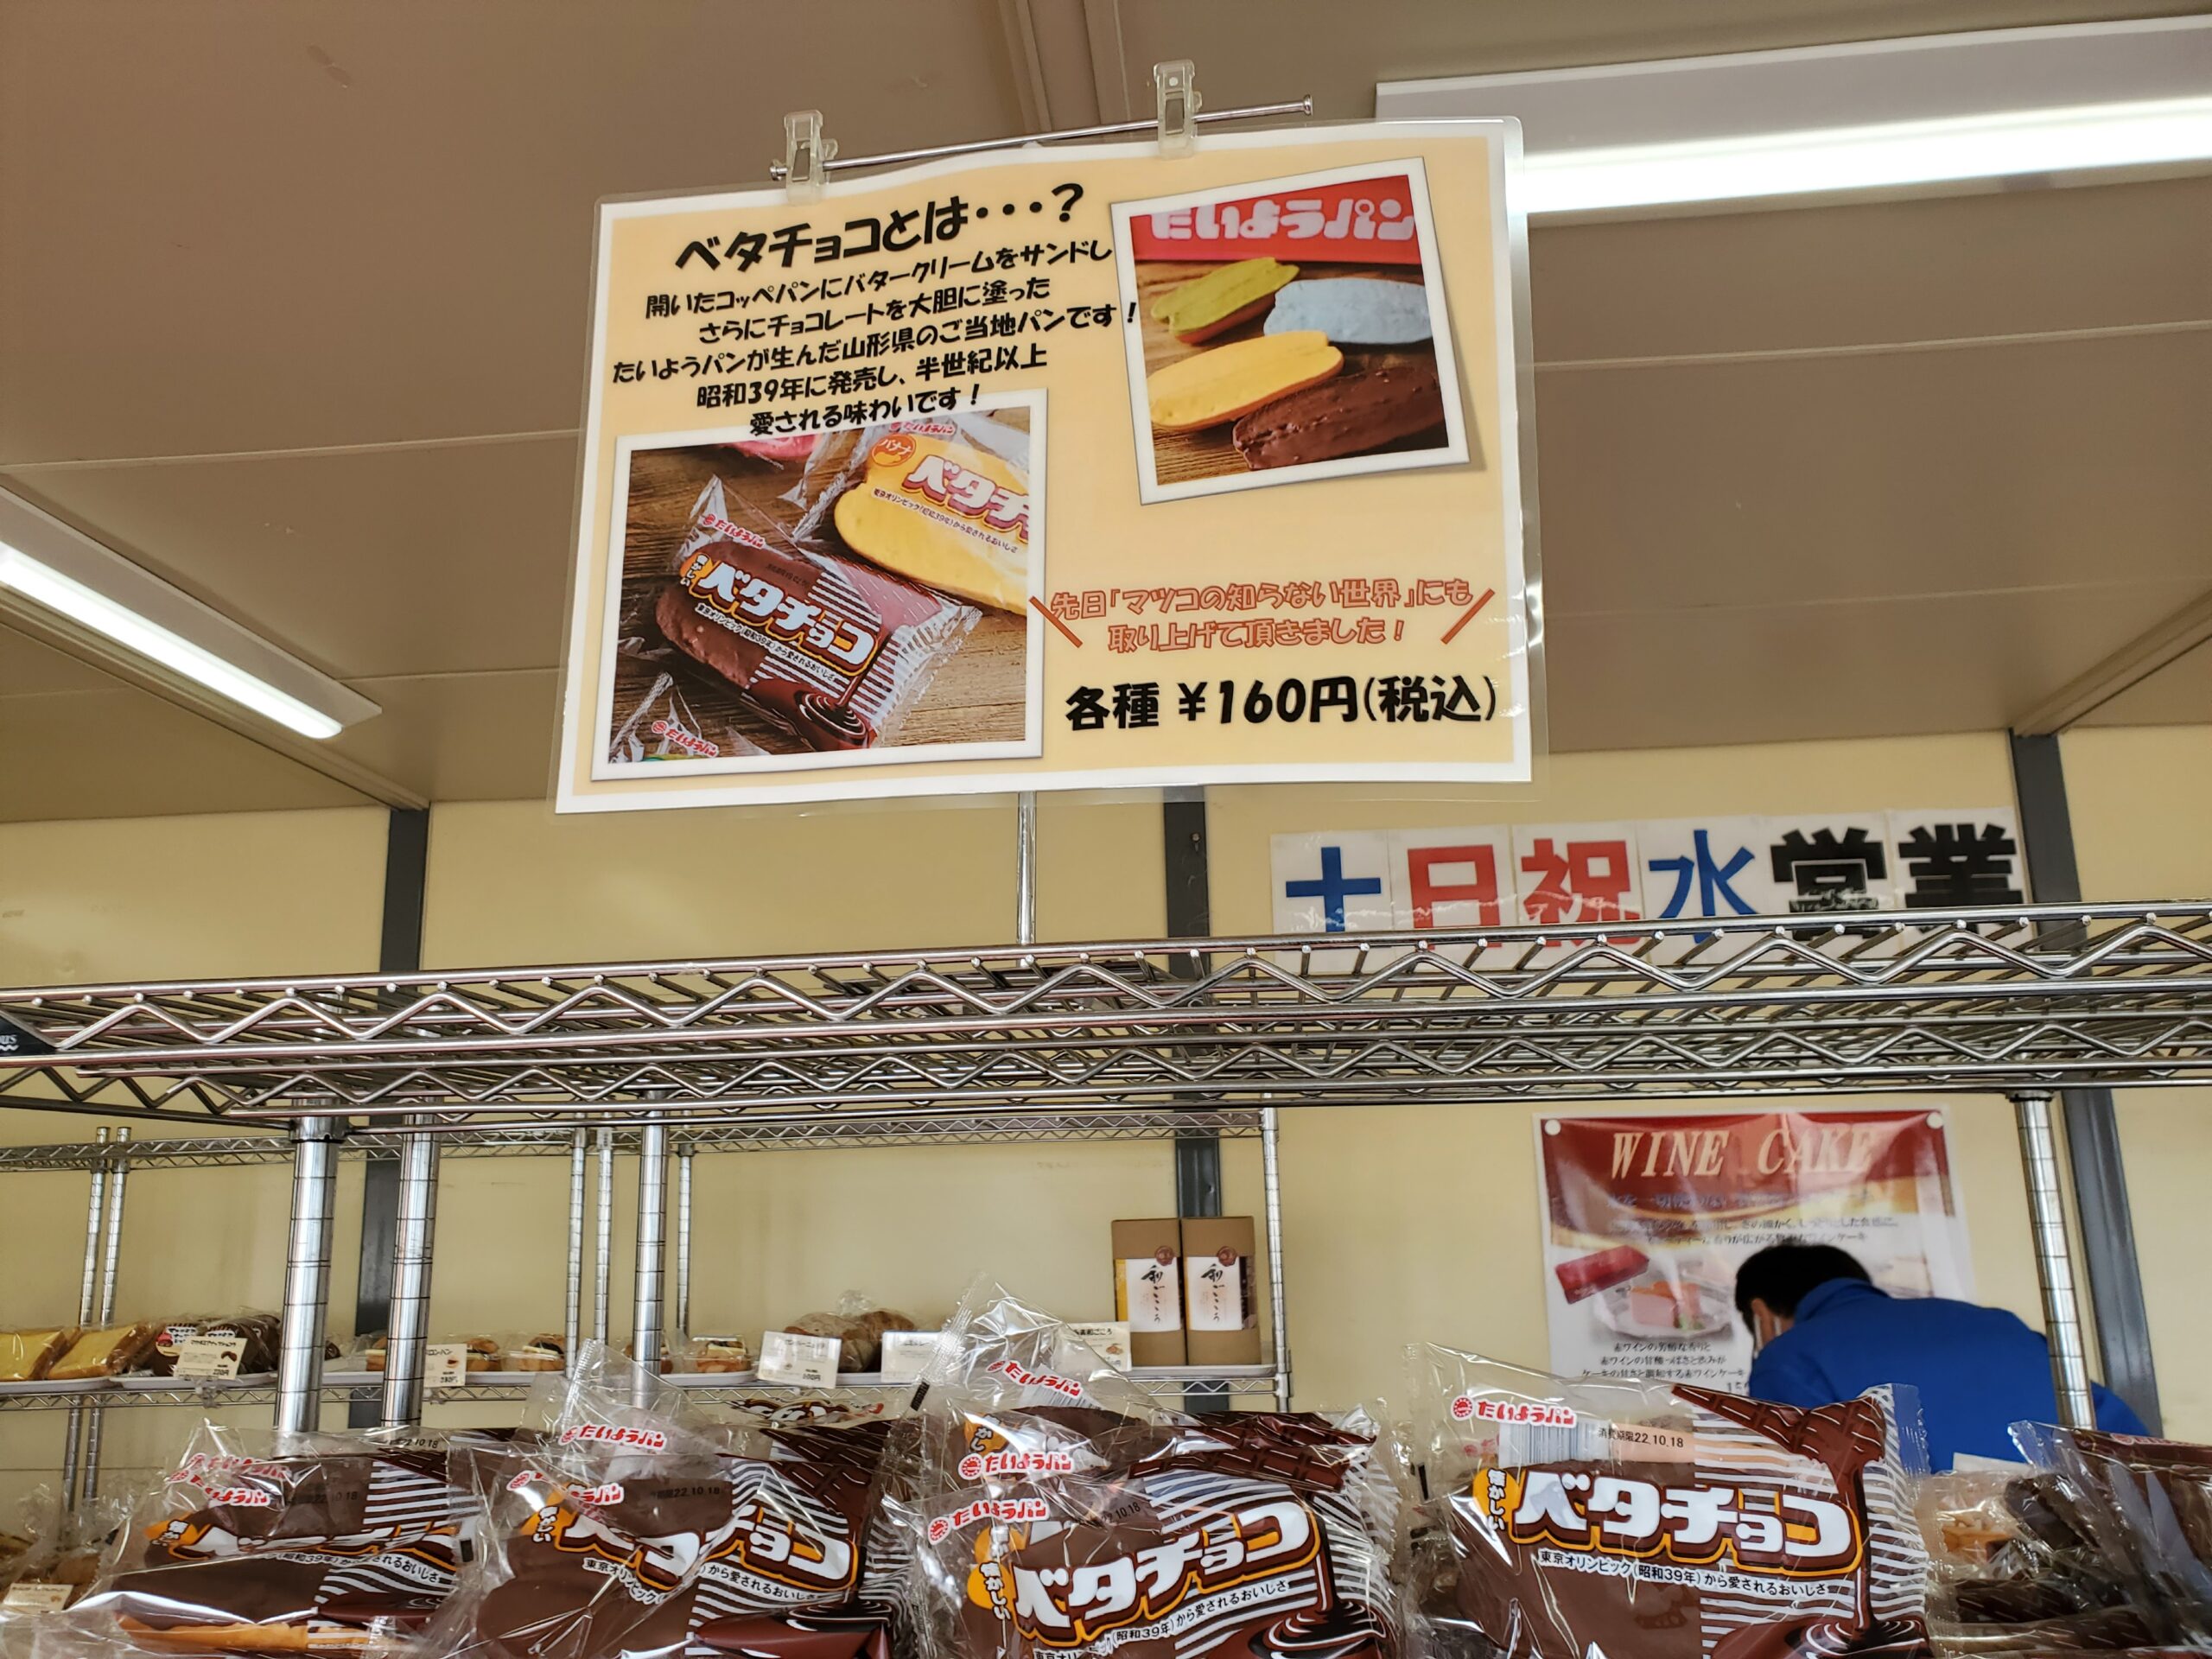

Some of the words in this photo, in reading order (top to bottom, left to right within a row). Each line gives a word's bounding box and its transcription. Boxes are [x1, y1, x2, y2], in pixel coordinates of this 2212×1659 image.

[645, 240, 1113, 319] 開いたコッペパンにバタークリームをサンドし
[698, 277, 1051, 344] さらにチョコレートを大胆に塗った
[613, 302, 1136, 383] たいようパンが生んだ山形県のご当地パンです！
[696, 343, 1047, 409] 昭和39年に発売し、半世紀以上
[750, 384, 980, 436] 愛される味わいです！
[698, 562, 875, 665] ベタチョコ
[1051, 578, 1472, 620] 先日「マツコの知らない世界」にも
[1108, 616, 1404, 652] 取り上げて頂きました！
[1065, 682, 1160, 730] 各種
[1611, 1130, 1731, 1179] WINE
[1758, 1127, 1877, 1175] CAKE
[580, 1424, 664, 1447] たいようパン
[1478, 1401, 1575, 1424] たいようパン
[985, 1454, 1071, 1473] たいようパン
[952, 1500, 1047, 1527] たいようパン
[1515, 1471, 1853, 1559] ベタチョコ
[1014, 1503, 1310, 1628] ベタチョコ
